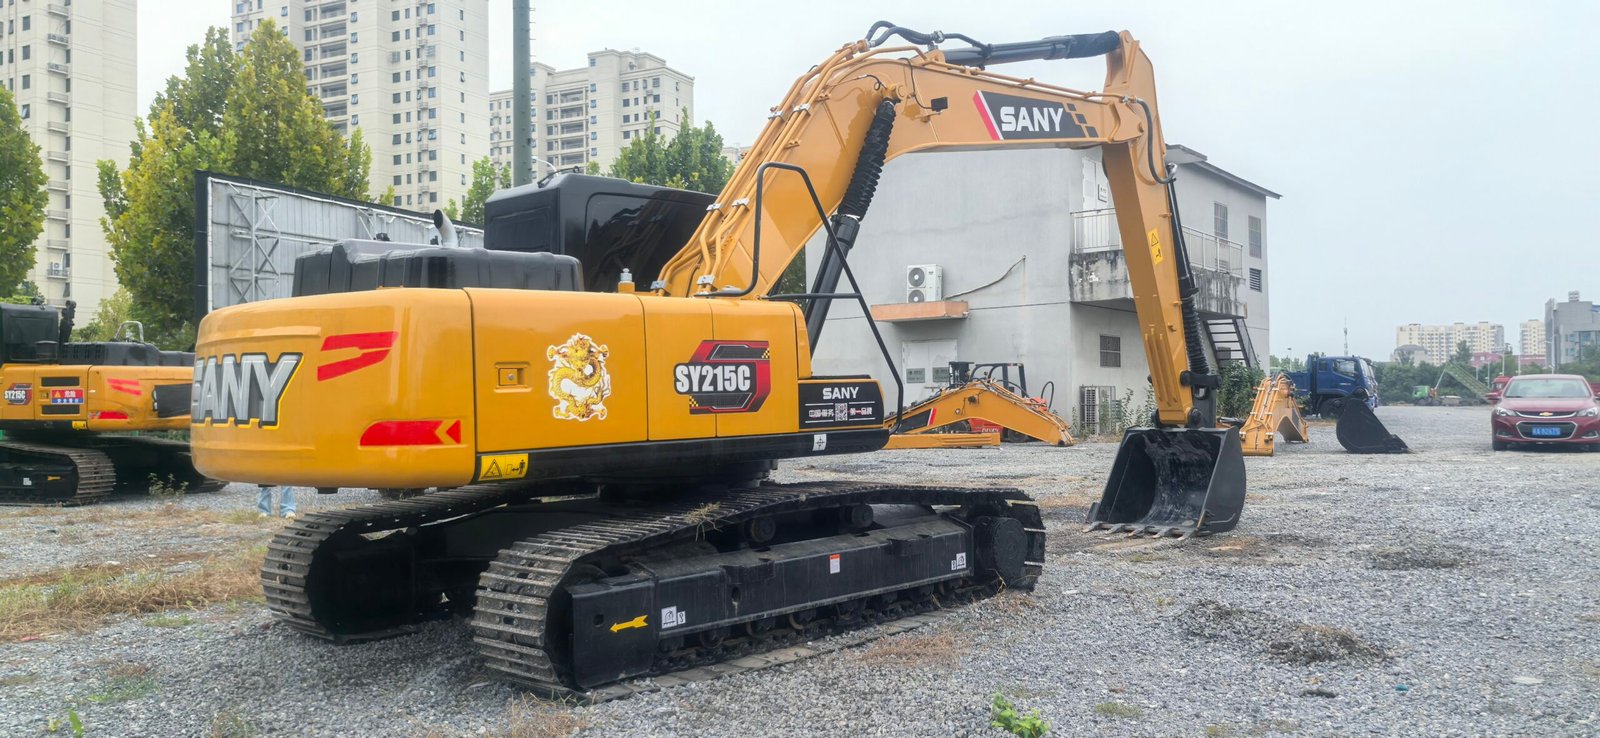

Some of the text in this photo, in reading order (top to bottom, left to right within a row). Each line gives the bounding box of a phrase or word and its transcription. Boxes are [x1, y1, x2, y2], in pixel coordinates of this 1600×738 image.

[1000, 106, 1063, 132] SANY
[675, 364, 751, 393] SY215C
[4, 390, 26, 399] SY215C
[822, 386, 860, 400] SANY
